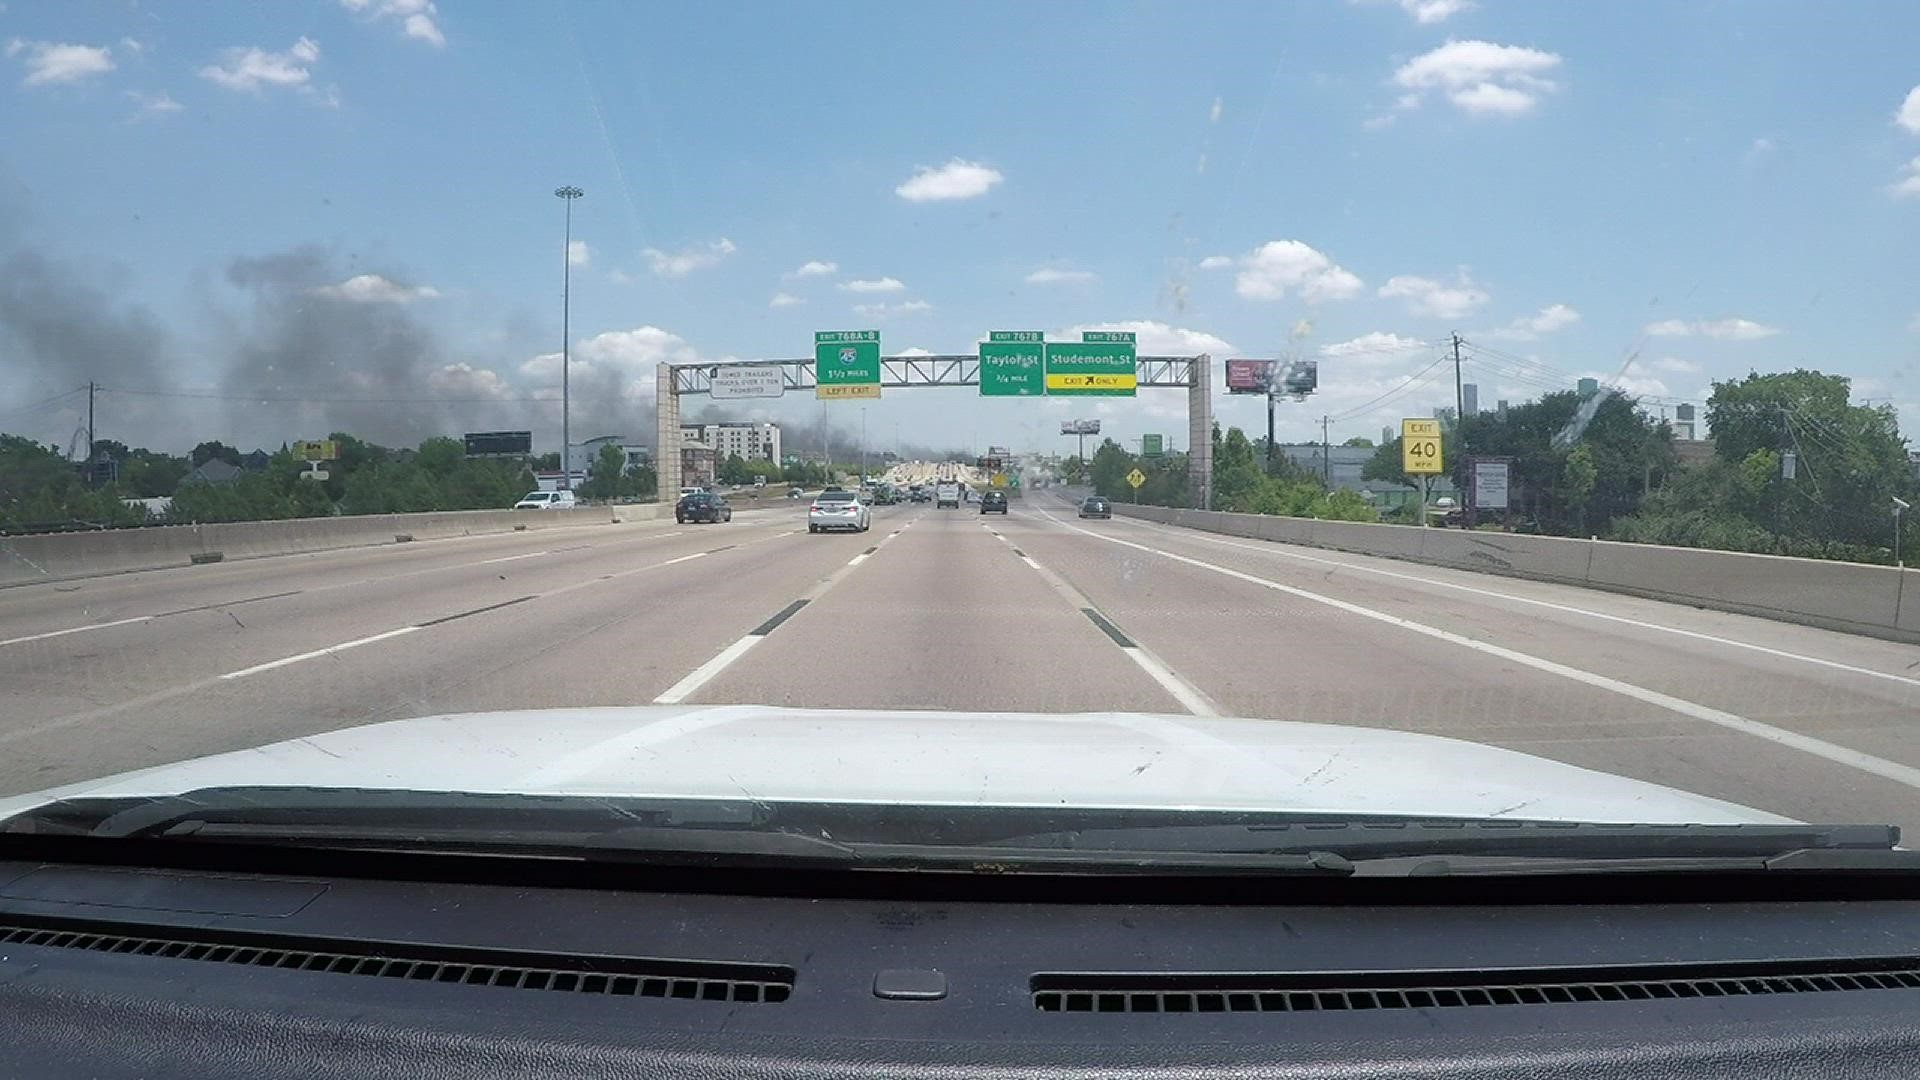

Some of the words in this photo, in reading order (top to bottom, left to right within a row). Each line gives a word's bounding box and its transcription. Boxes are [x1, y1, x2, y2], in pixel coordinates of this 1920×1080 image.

[1013, 332, 1038, 341] 767B
[1106, 332, 1131, 341] 767A
[985, 354, 1021, 367] Taylor
[1029, 355, 1039, 365] St
[1051, 354, 1114, 365] Studemont
[1119, 355, 1131, 365] St
[1011, 374, 1028, 382] MILE
[1063, 377, 1083, 385] EXIT
[1095, 377, 1119, 385] ONLY
[826, 388, 846, 396] LEFT
[850, 387, 870, 395] EXIT
[1411, 423, 1432, 433] EXIT
[1410, 442, 1436, 458] 40
